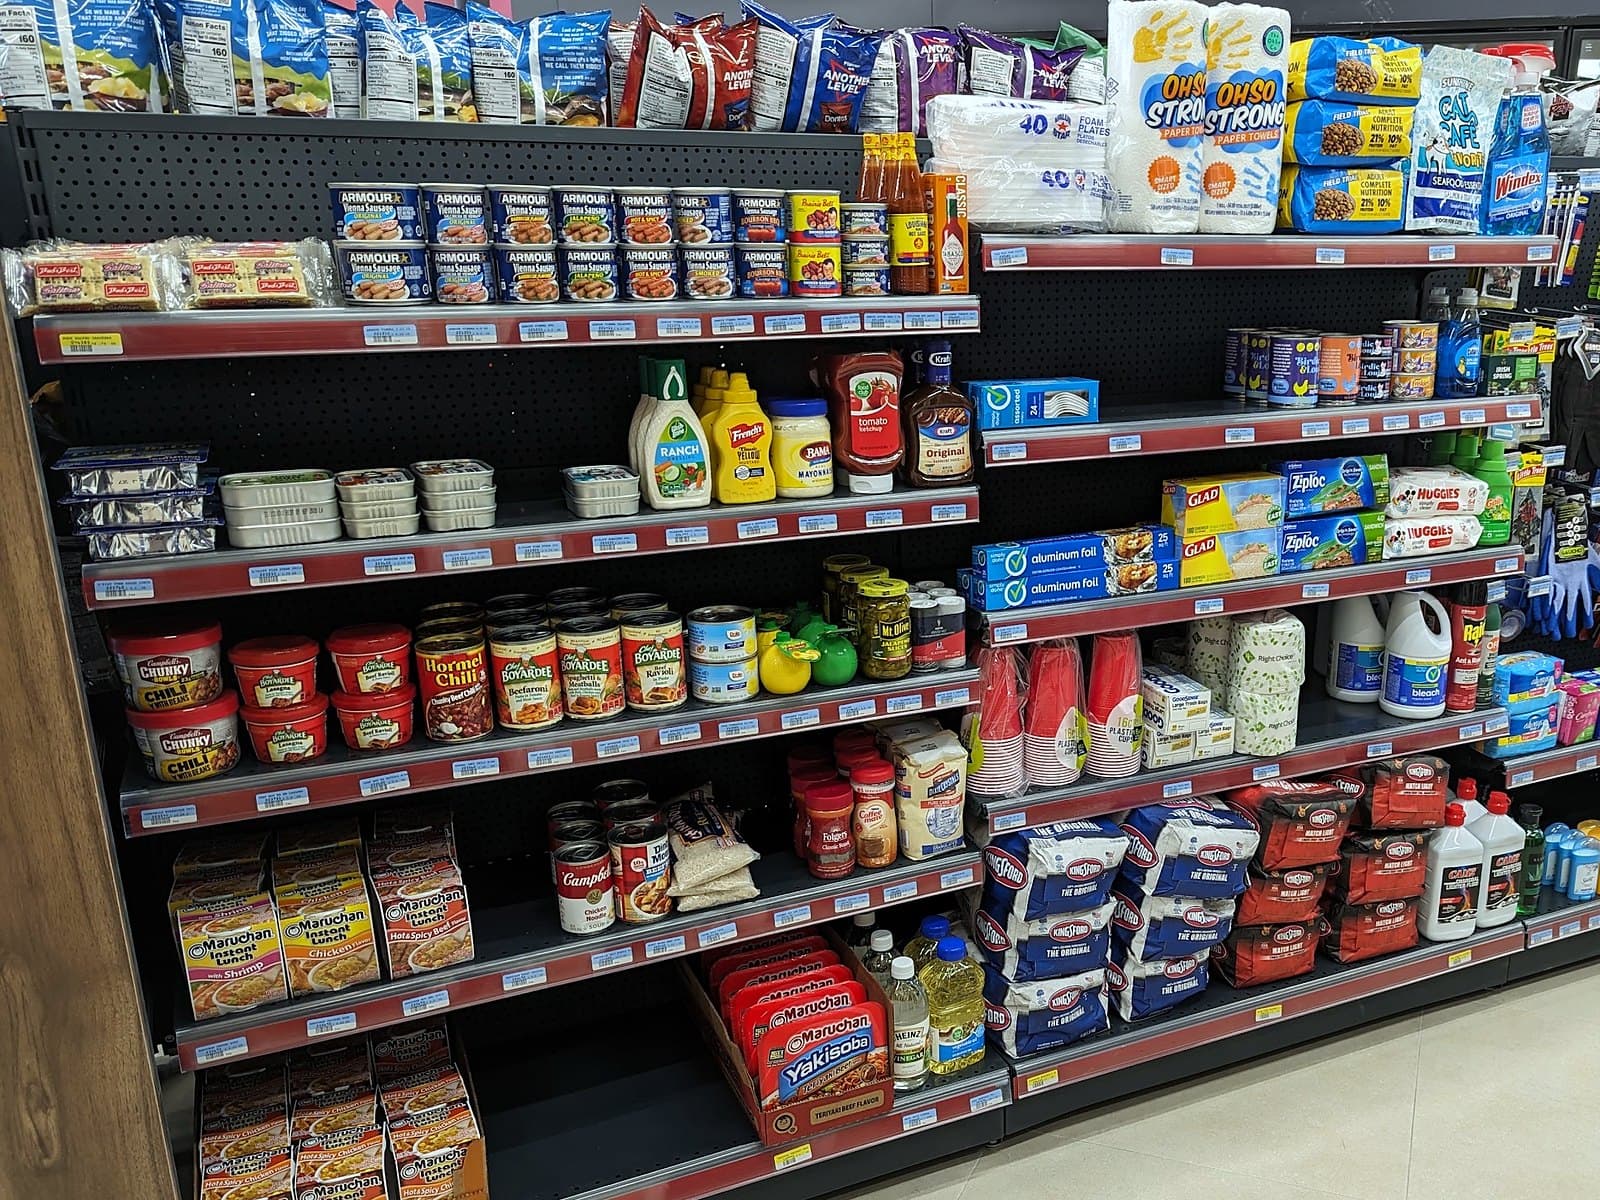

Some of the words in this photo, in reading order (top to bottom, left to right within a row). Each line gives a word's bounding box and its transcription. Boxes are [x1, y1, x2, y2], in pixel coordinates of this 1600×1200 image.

[211, 47, 227, 57] 160
[503, 71, 516, 79] 160
[827, 82, 860, 95] LEVEL
[1438, 91, 1469, 121] CAT
[824, 113, 848, 124] Doritos
[1080, 115, 1104, 127] FOAM
[1203, 101, 1285, 136] STRONG
[1333, 111, 1352, 121] FIELD
[1372, 116, 1404, 125] COMPLETE
[1020, 114, 1048, 136] 40
[1078, 123, 1111, 137] PLATES
[1370, 123, 1404, 132] NUTRITION
[1164, 127, 1191, 138] PAPER
[1217, 133, 1246, 145] PAPER
[1247, 130, 1279, 142] TOWELS
[1369, 133, 1385, 144] 21%
[1387, 132, 1403, 144] 10%
[1041, 169, 1070, 189] 40
[1153, 175, 1176, 185] SMART
[1323, 178, 1341, 188] FIELD
[1360, 181, 1392, 190] COMPLETE
[1207, 181, 1232, 191] SMART
[1360, 188, 1393, 197] NUTRITION
[1494, 171, 1542, 203] Windex
[341, 193, 393, 204] ARMOUR
[436, 194, 482, 205] ARMOUR
[501, 194, 547, 205] ARMOUR
[955, 176, 966, 218] CLASSIC
[1211, 188, 1229, 198] SIZED
[365, 204, 394, 214] Sausage
[563, 204, 585, 214] Vienna
[1377, 198, 1391, 208] 10%
[624, 205, 645, 215] Vienna
[925, 188, 936, 280] TABASCO
[350, 253, 400, 264] ARMOUR
[509, 253, 553, 264] ARMOUR
[352, 263, 372, 273] Vienna
[372, 264, 401, 274] Sausage
[454, 264, 481, 274] Sausage
[694, 269, 721, 277] SMOKED
[1493, 372, 1513, 381] SPRING
[1495, 366, 1510, 374] IRISH
[1013, 388, 1022, 425] assorted
[1029, 405, 1038, 417] 24
[859, 416, 888, 427] tomato
[732, 423, 764, 443] French's
[858, 426, 883, 435] ketchup
[939, 427, 952, 435] Kraft
[660, 445, 699, 457] RANCH
[738, 451, 761, 461] YELLOW
[926, 447, 965, 461] Original
[1530, 466, 1545, 477] Trees
[1291, 473, 1326, 495] Ziploc
[1187, 488, 1219, 508] GLAD
[1416, 488, 1461, 501] HUGGIES
[1158, 532, 1169, 544] 25
[1285, 534, 1320, 555] Ziploc
[1184, 539, 1215, 559] GLAD
[1031, 551, 1078, 566] aluminum
[1081, 546, 1097, 558] foil
[1162, 563, 1173, 574] 25
[1031, 580, 1078, 595] aluminum
[1082, 577, 1099, 590] foil
[638, 643, 654, 655] Chef
[425, 652, 484, 673] Hormel
[634, 650, 681, 666] BOYARDEE
[1258, 654, 1275, 664] Right
[1275, 653, 1294, 663] Choice
[139, 664, 189, 679] CHUNKY
[561, 659, 609, 673] BOYARDEE
[436, 669, 477, 688] Chili
[501, 667, 552, 683] BOYARDEE
[646, 668, 674, 680] Ravioli
[508, 684, 548, 698] Beefaroni
[568, 680, 601, 690] Meatballs
[144, 684, 187, 703] CHILI
[451, 690, 464, 702] Beef
[1411, 687, 1440, 699] bleach
[162, 736, 210, 751] CHUNKY
[167, 755, 209, 775] CHILI
[192, 764, 211, 777] BEANS
[859, 809, 882, 821] Coffee
[863, 814, 884, 826] mate
[822, 830, 848, 844] Folgers
[1034, 824, 1054, 838] THE
[1305, 828, 1322, 837] MATCH
[985, 850, 1023, 884] KINGSFORD
[1068, 862, 1102, 877] KINGSFORD
[1201, 871, 1229, 883] ORIGINAL
[1071, 884, 1098, 897] ORIGINAL
[1296, 888, 1311, 897] LIGHT
[398, 890, 464, 914] Maruchan
[405, 903, 449, 922] Instant
[584, 904, 608, 917] Chicken
[299, 910, 366, 932] Maruchan
[411, 913, 446, 928] Lunch
[586, 912, 608, 923] Noodle
[305, 923, 352, 940] Instant
[433, 920, 452, 939] Beef
[1052, 924, 1089, 938] KINGSFORD
[311, 931, 348, 947] Lunch
[1190, 931, 1218, 943] ORIGINAL
[210, 944, 258, 960] Instant
[309, 942, 353, 960] Chicken
[1046, 949, 1060, 958] THE
[1060, 944, 1091, 958] ORIGINAL
[1272, 944, 1290, 956] MATCH
[1289, 942, 1304, 953] LIGHT
[216, 951, 255, 967] Lunch
[224, 960, 265, 981] Shrimp
[783, 994, 849, 1021] Maruchan
[801, 1015, 869, 1045] Maruchan
[895, 1029, 922, 1042] HEINZ
[783, 1036, 869, 1090] Yakisoba
[814, 1107, 841, 1120] TERIYAKI
[840, 1103, 856, 1114] BEEF
[856, 1096, 881, 1110] FLAVOR
[338, 1141, 369, 1160] Chicken
[224, 1158, 272, 1175] Instant
[314, 1175, 382, 1200] Maruchan
